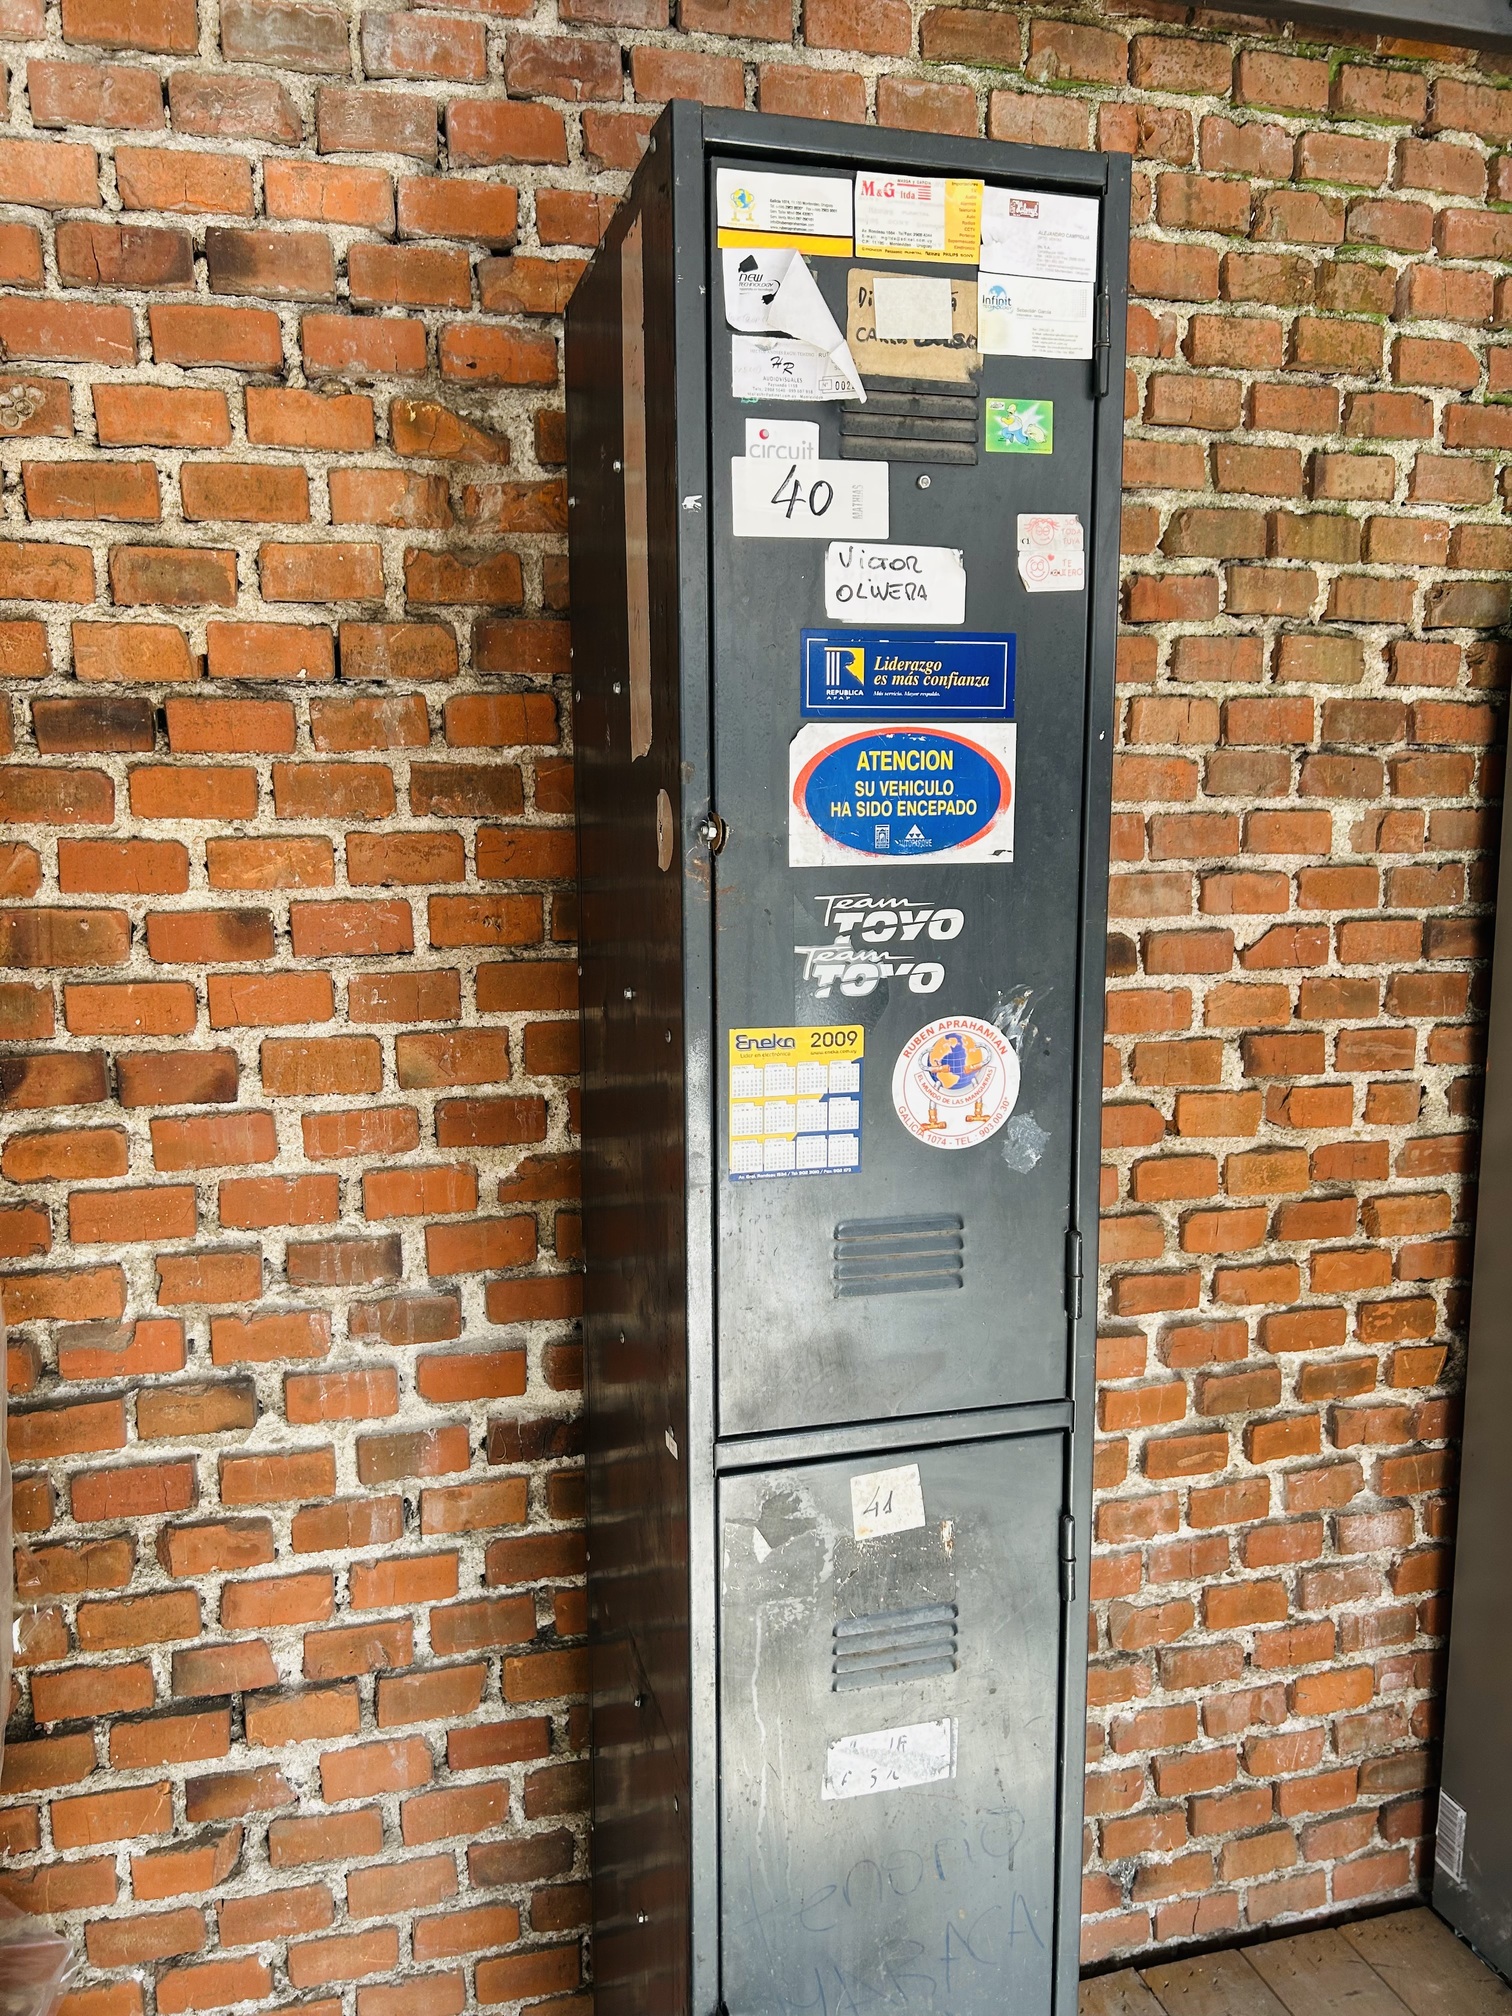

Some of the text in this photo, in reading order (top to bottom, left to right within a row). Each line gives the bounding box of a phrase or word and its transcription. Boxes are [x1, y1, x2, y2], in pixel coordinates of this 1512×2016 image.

[982, 294, 1012, 306] Infinit
[750, 436, 814, 460] circuit
[771, 464, 834, 519] 40
[873, 655, 942, 674] Liderazgo
[873, 669, 990, 690] es más confianza
[826, 689, 864, 697] REPUBLICA
[856, 749, 954, 771] ATENCION
[855, 779, 954, 797] SU VEHICULO
[830, 799, 977, 818] HA SIDO ENCEPADO
[814, 893, 935, 927] Team
[833, 908, 965, 943] TOYO
[794, 946, 915, 981] Team
[735, 1030, 858, 1050] Eneka 2009
[903, 1020, 1008, 1059] RUBEN APRAHAMIAN
[922, 1082, 941, 1101] MUNDO
[965, 1068, 994, 1103] MANGUERAS
[898, 1105, 925, 1140] GALICIA
[927, 1133, 947, 1146] 1074
[863, 1486, 894, 1517] 41
